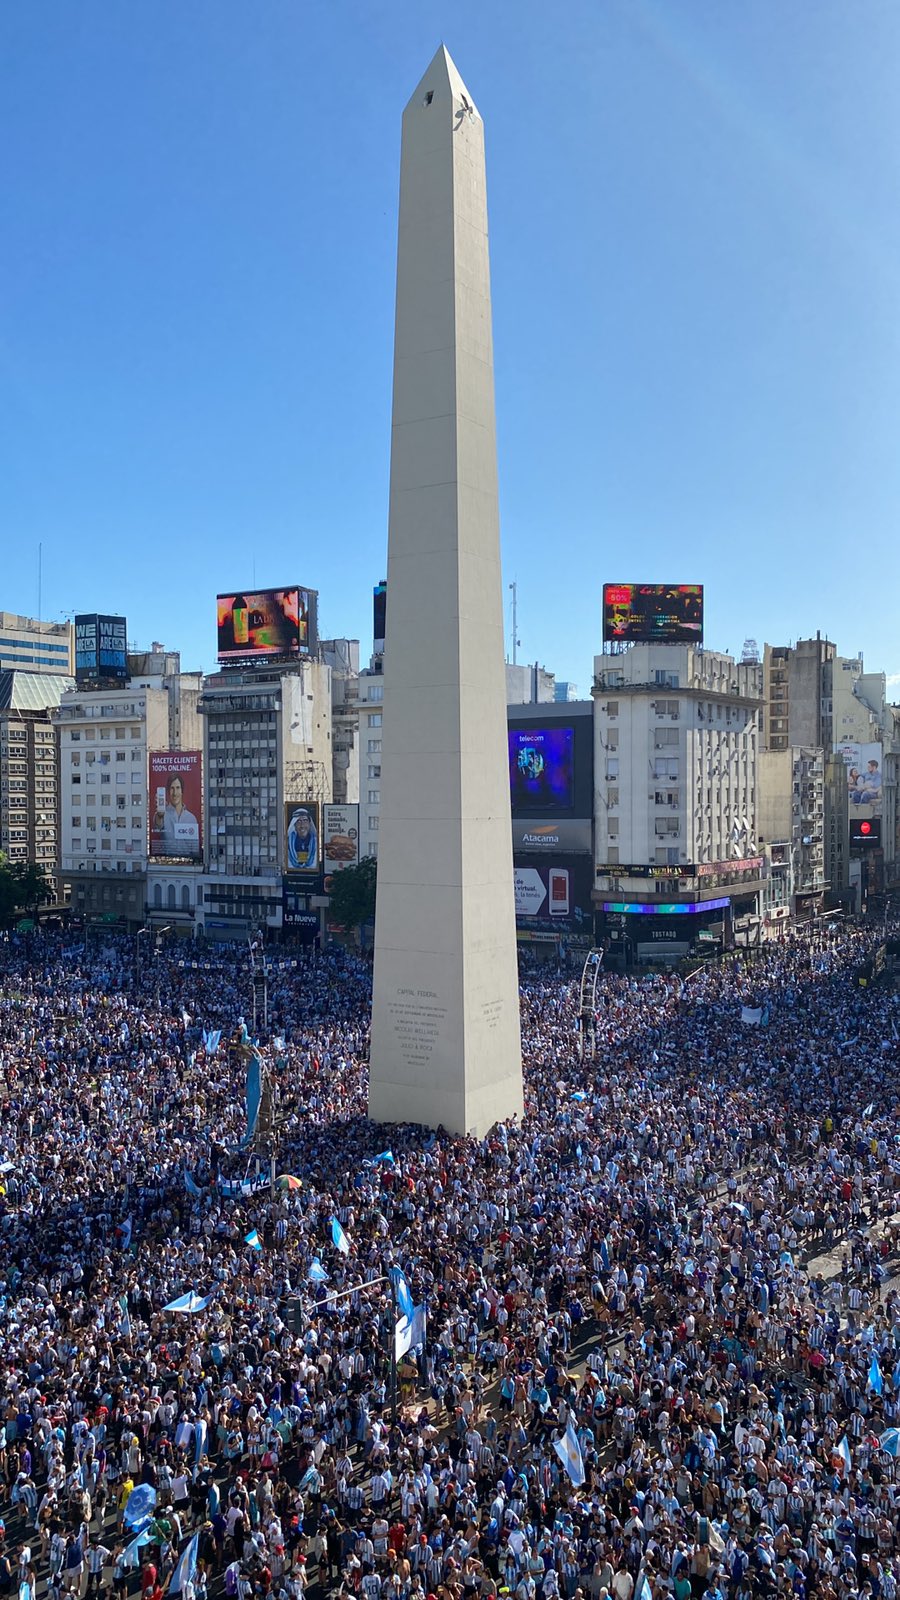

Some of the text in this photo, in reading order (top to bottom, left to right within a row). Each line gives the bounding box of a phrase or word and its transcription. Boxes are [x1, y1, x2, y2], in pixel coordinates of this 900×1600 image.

[76, 624, 97, 637] WE
[100, 622, 125, 637] WE
[173, 756, 197, 764] CLIENTE
[168, 764, 192, 772] ONLINE.
[522, 833, 559, 842] Atacama
[284, 914, 317, 923] La Nueve
[250, 1171, 270, 1191] PAZ
[367, 1584, 378, 1595] 10
